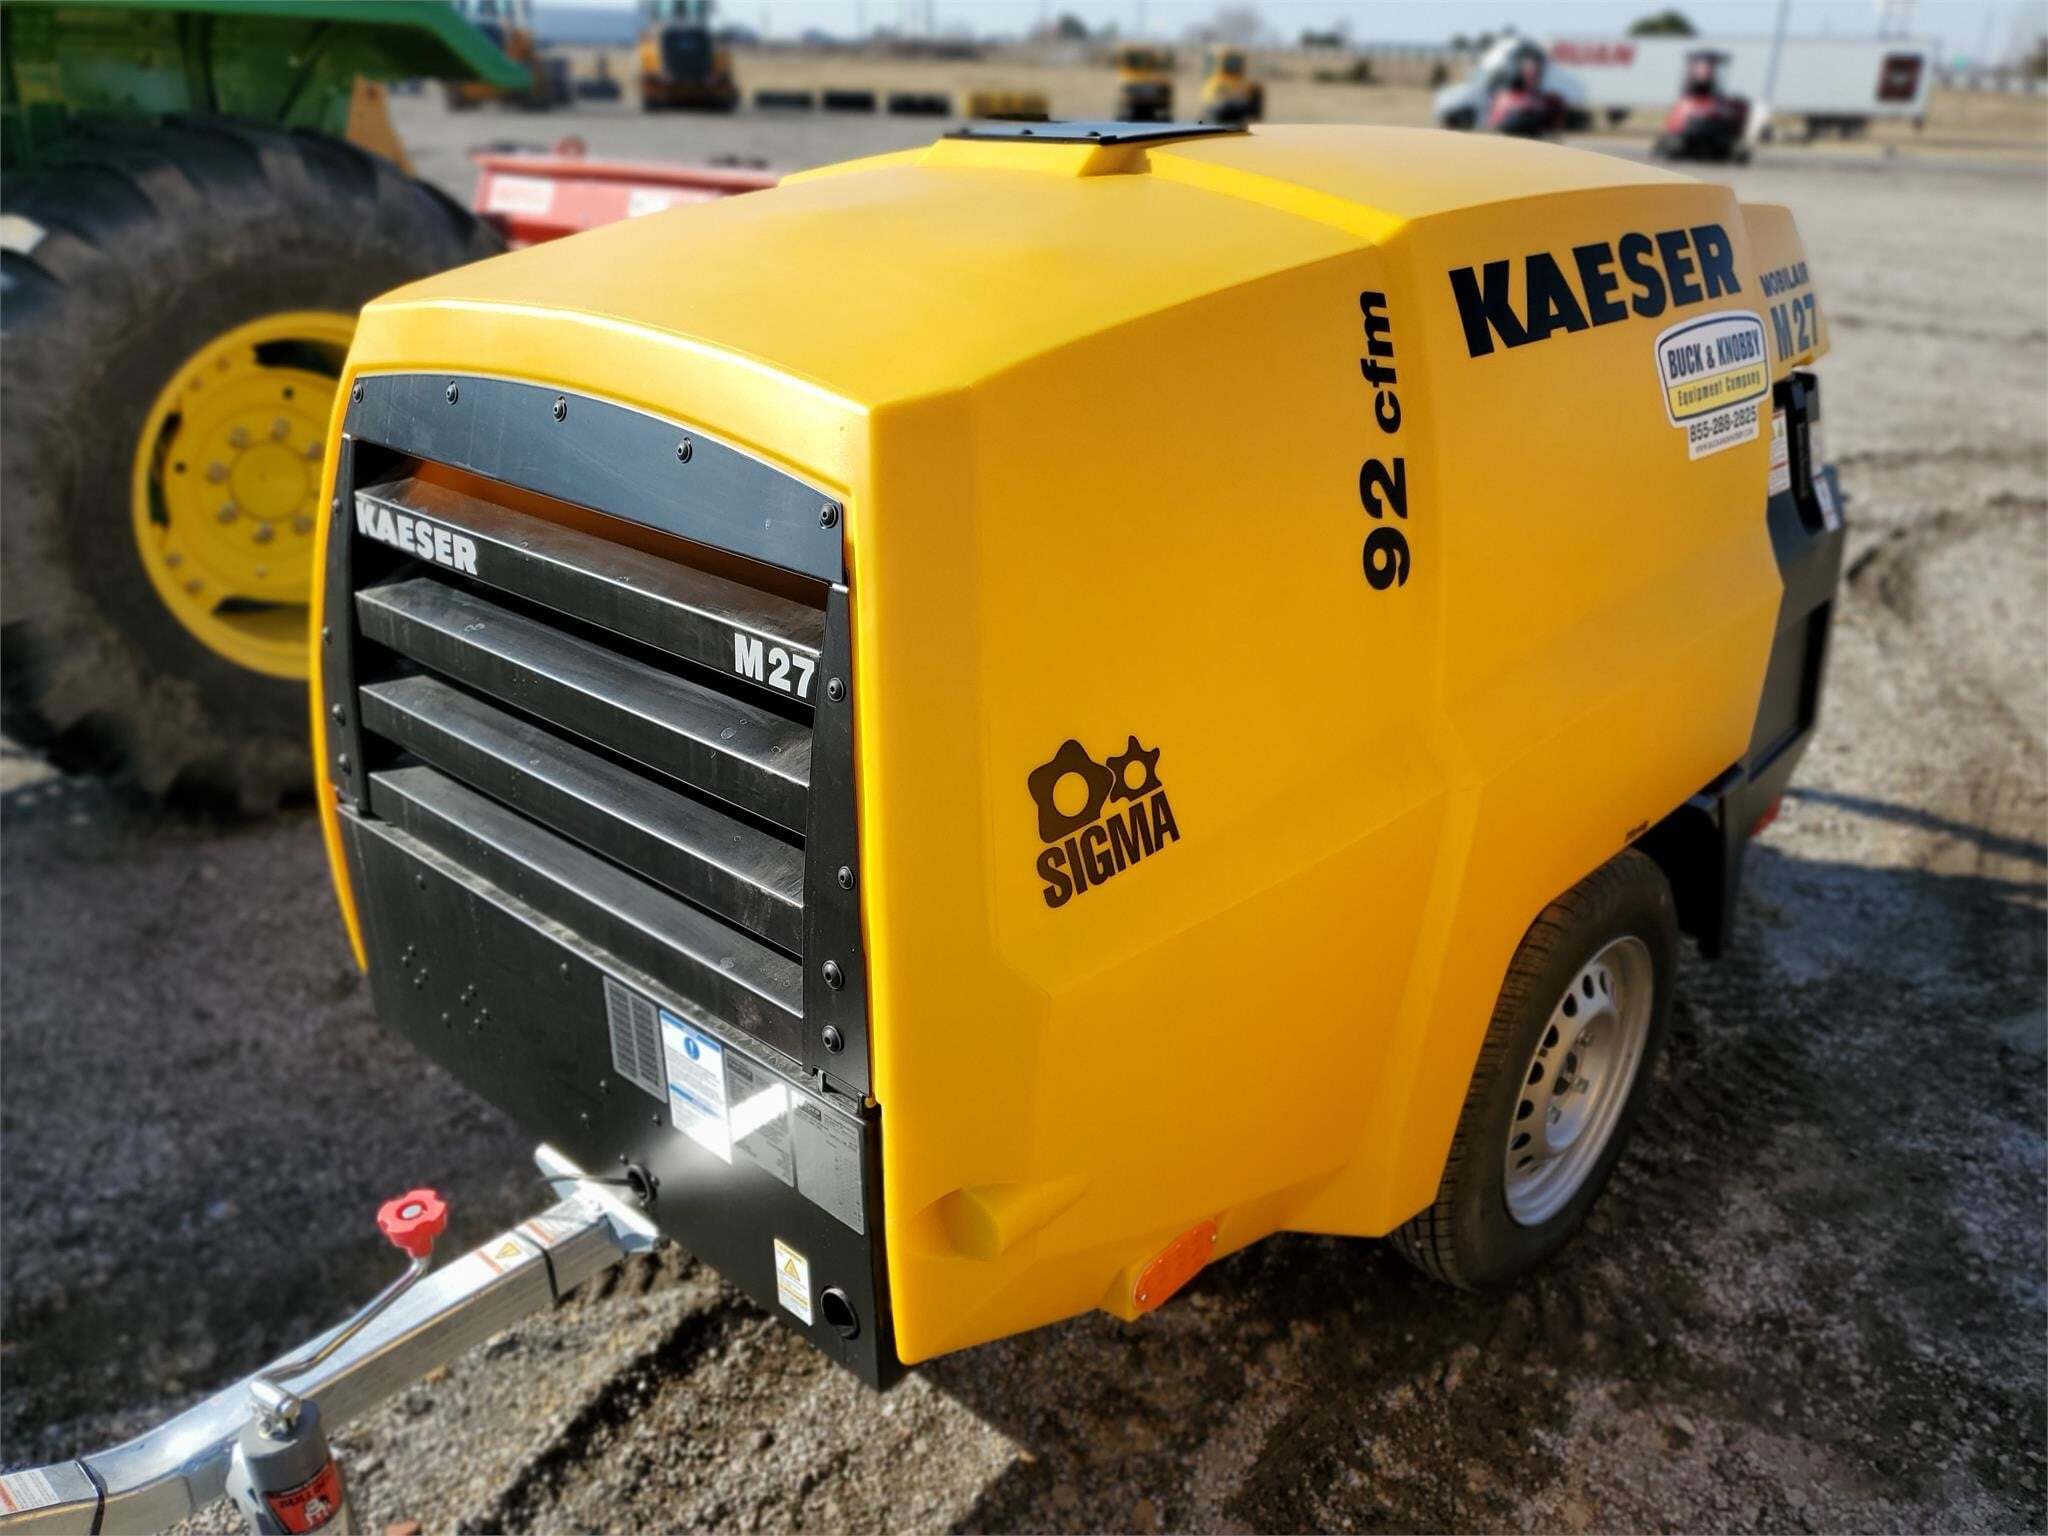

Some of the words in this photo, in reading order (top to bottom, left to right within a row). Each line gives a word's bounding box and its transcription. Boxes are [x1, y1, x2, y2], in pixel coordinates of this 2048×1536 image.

[1448, 224, 1741, 358] KAESER
[1760, 262, 1808, 298] MOBILAIR
[1360, 290, 1401, 434] cfm
[1667, 343, 1704, 379] BUCK
[1705, 345, 1716, 369] &
[1716, 328, 1760, 365] KNOBBY
[1677, 380, 1723, 406] Equipment
[1725, 371, 1761, 392] Company
[355, 500, 477, 575] KAESER
[1359, 457, 1410, 590] 92
[1036, 790, 1181, 909] SIGMA
